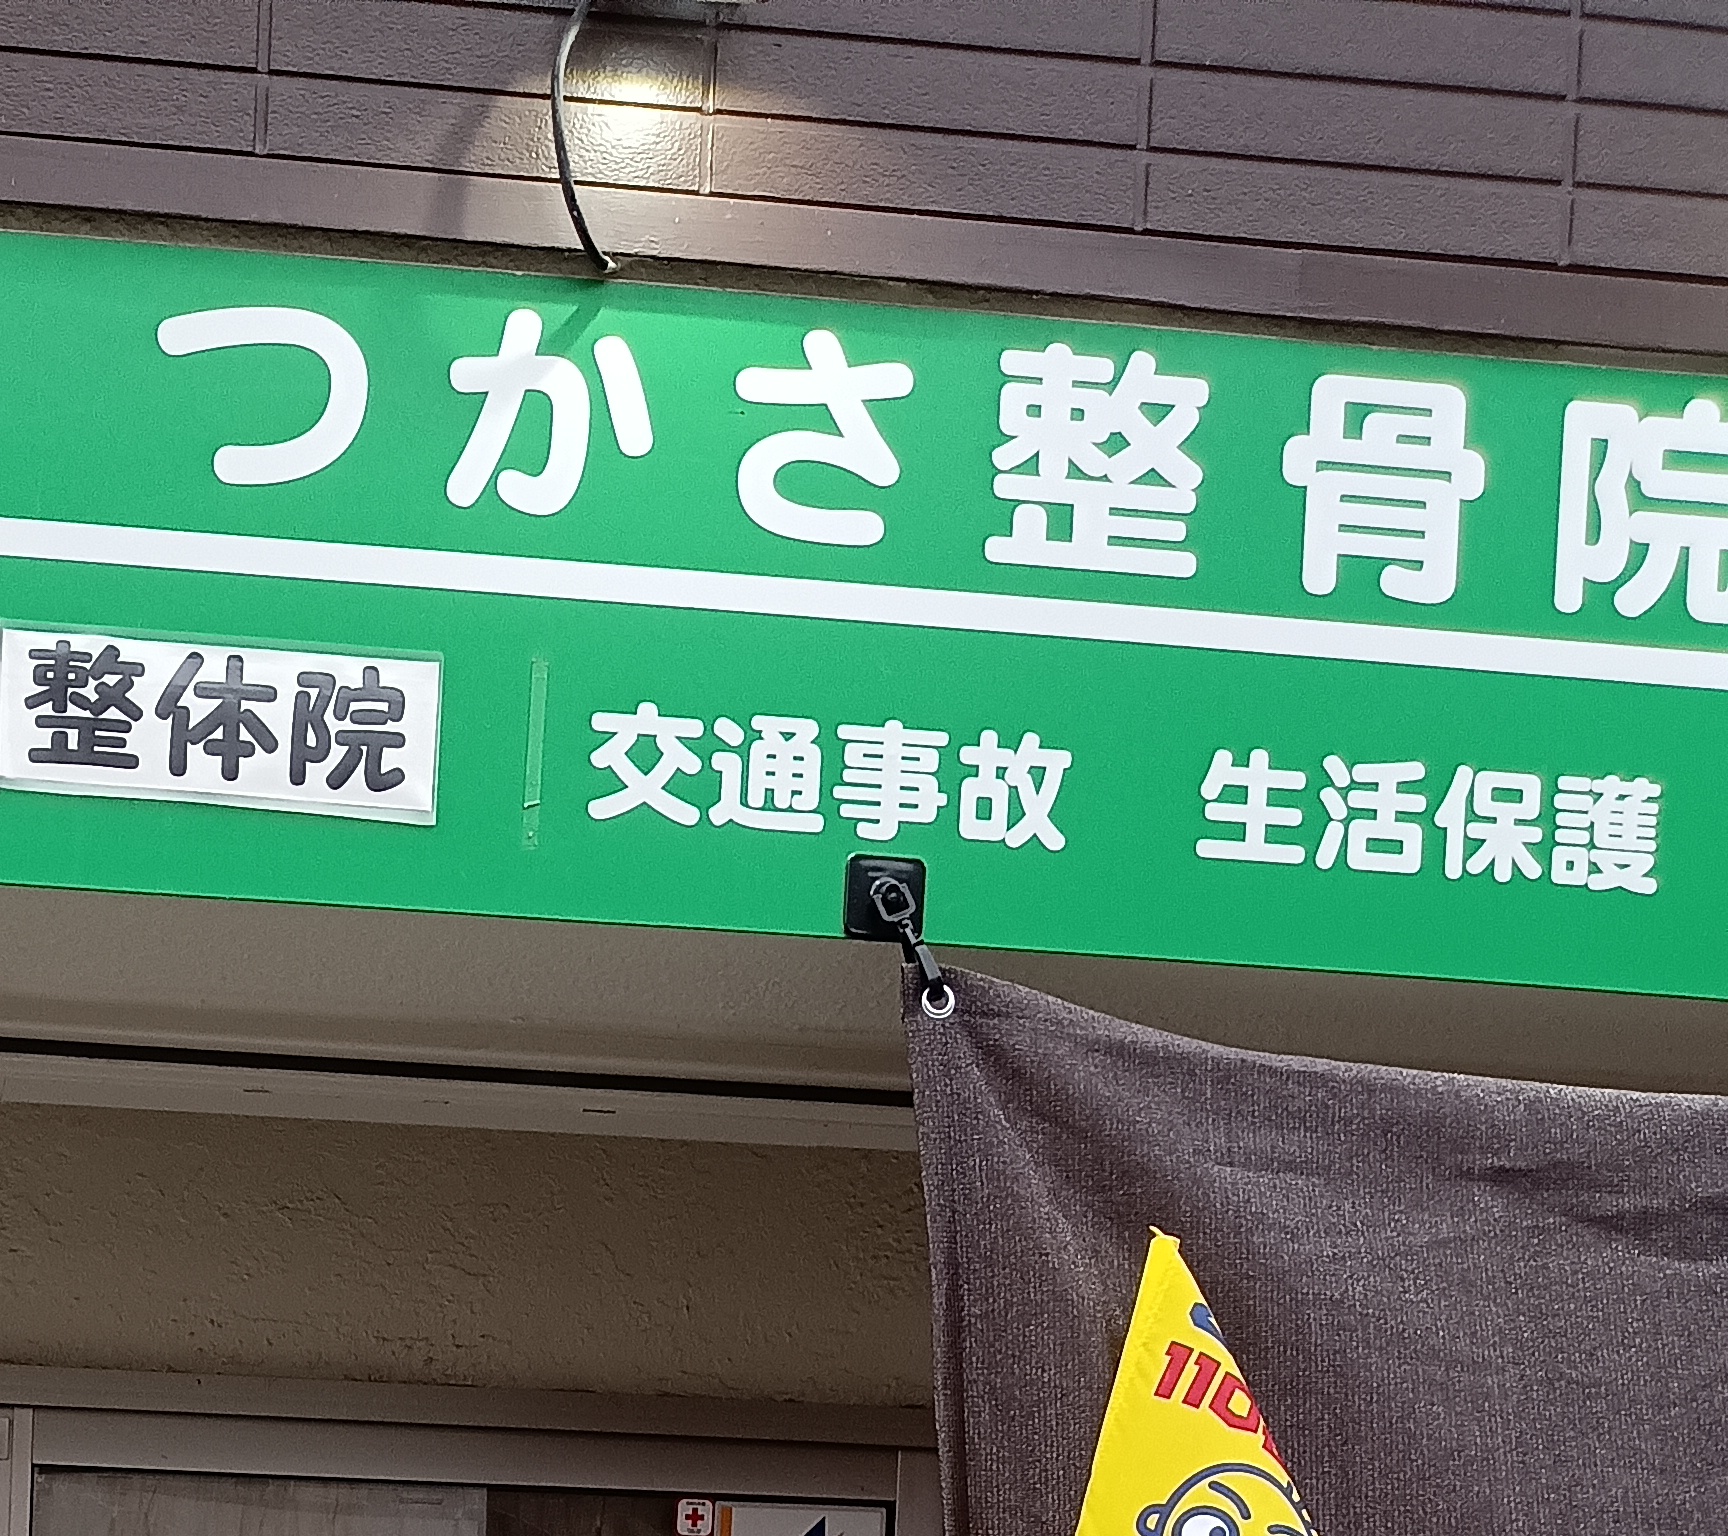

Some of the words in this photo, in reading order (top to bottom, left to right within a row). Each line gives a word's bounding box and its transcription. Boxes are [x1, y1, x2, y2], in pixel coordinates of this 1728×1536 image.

[156, 306, 1728, 625] つかさ整骨院
[23, 639, 407, 792] 整体院
[587, 702, 1073, 852] 交通事故
[1195, 748, 1664, 896] 生活保護
[1154, 1341, 1288, 1474] 110
